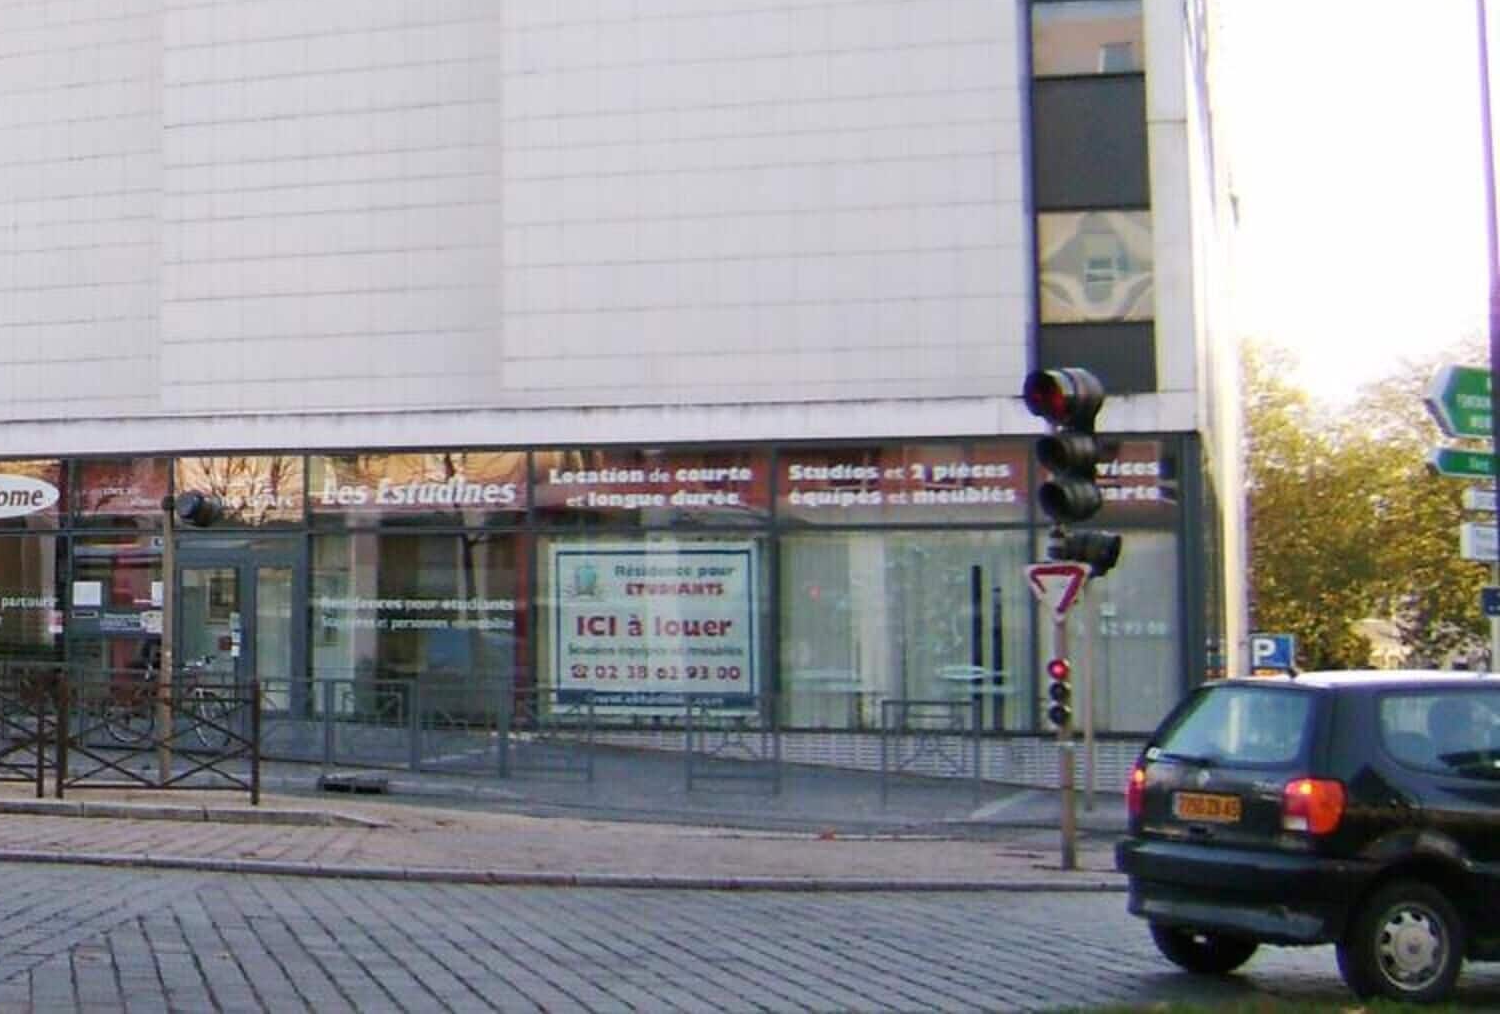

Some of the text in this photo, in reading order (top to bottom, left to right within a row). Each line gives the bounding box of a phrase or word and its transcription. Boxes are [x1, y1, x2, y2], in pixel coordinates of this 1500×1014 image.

[549, 467, 753, 483] Location de courte
[788, 461, 1010, 482] Studios et 2 pièces
[1094, 460, 1160, 475] vices
[321, 479, 368, 504] Les
[376, 476, 517, 504] Estudines
[566, 490, 740, 509] et longue durée
[788, 487, 1016, 506] équipés et meublés
[697, 567, 735, 579] pour
[576, 613, 732, 637] ICI à louer
[1253, 638, 1276, 667] P
[595, 665, 618, 679] 02
[717, 665, 742, 680] 00
